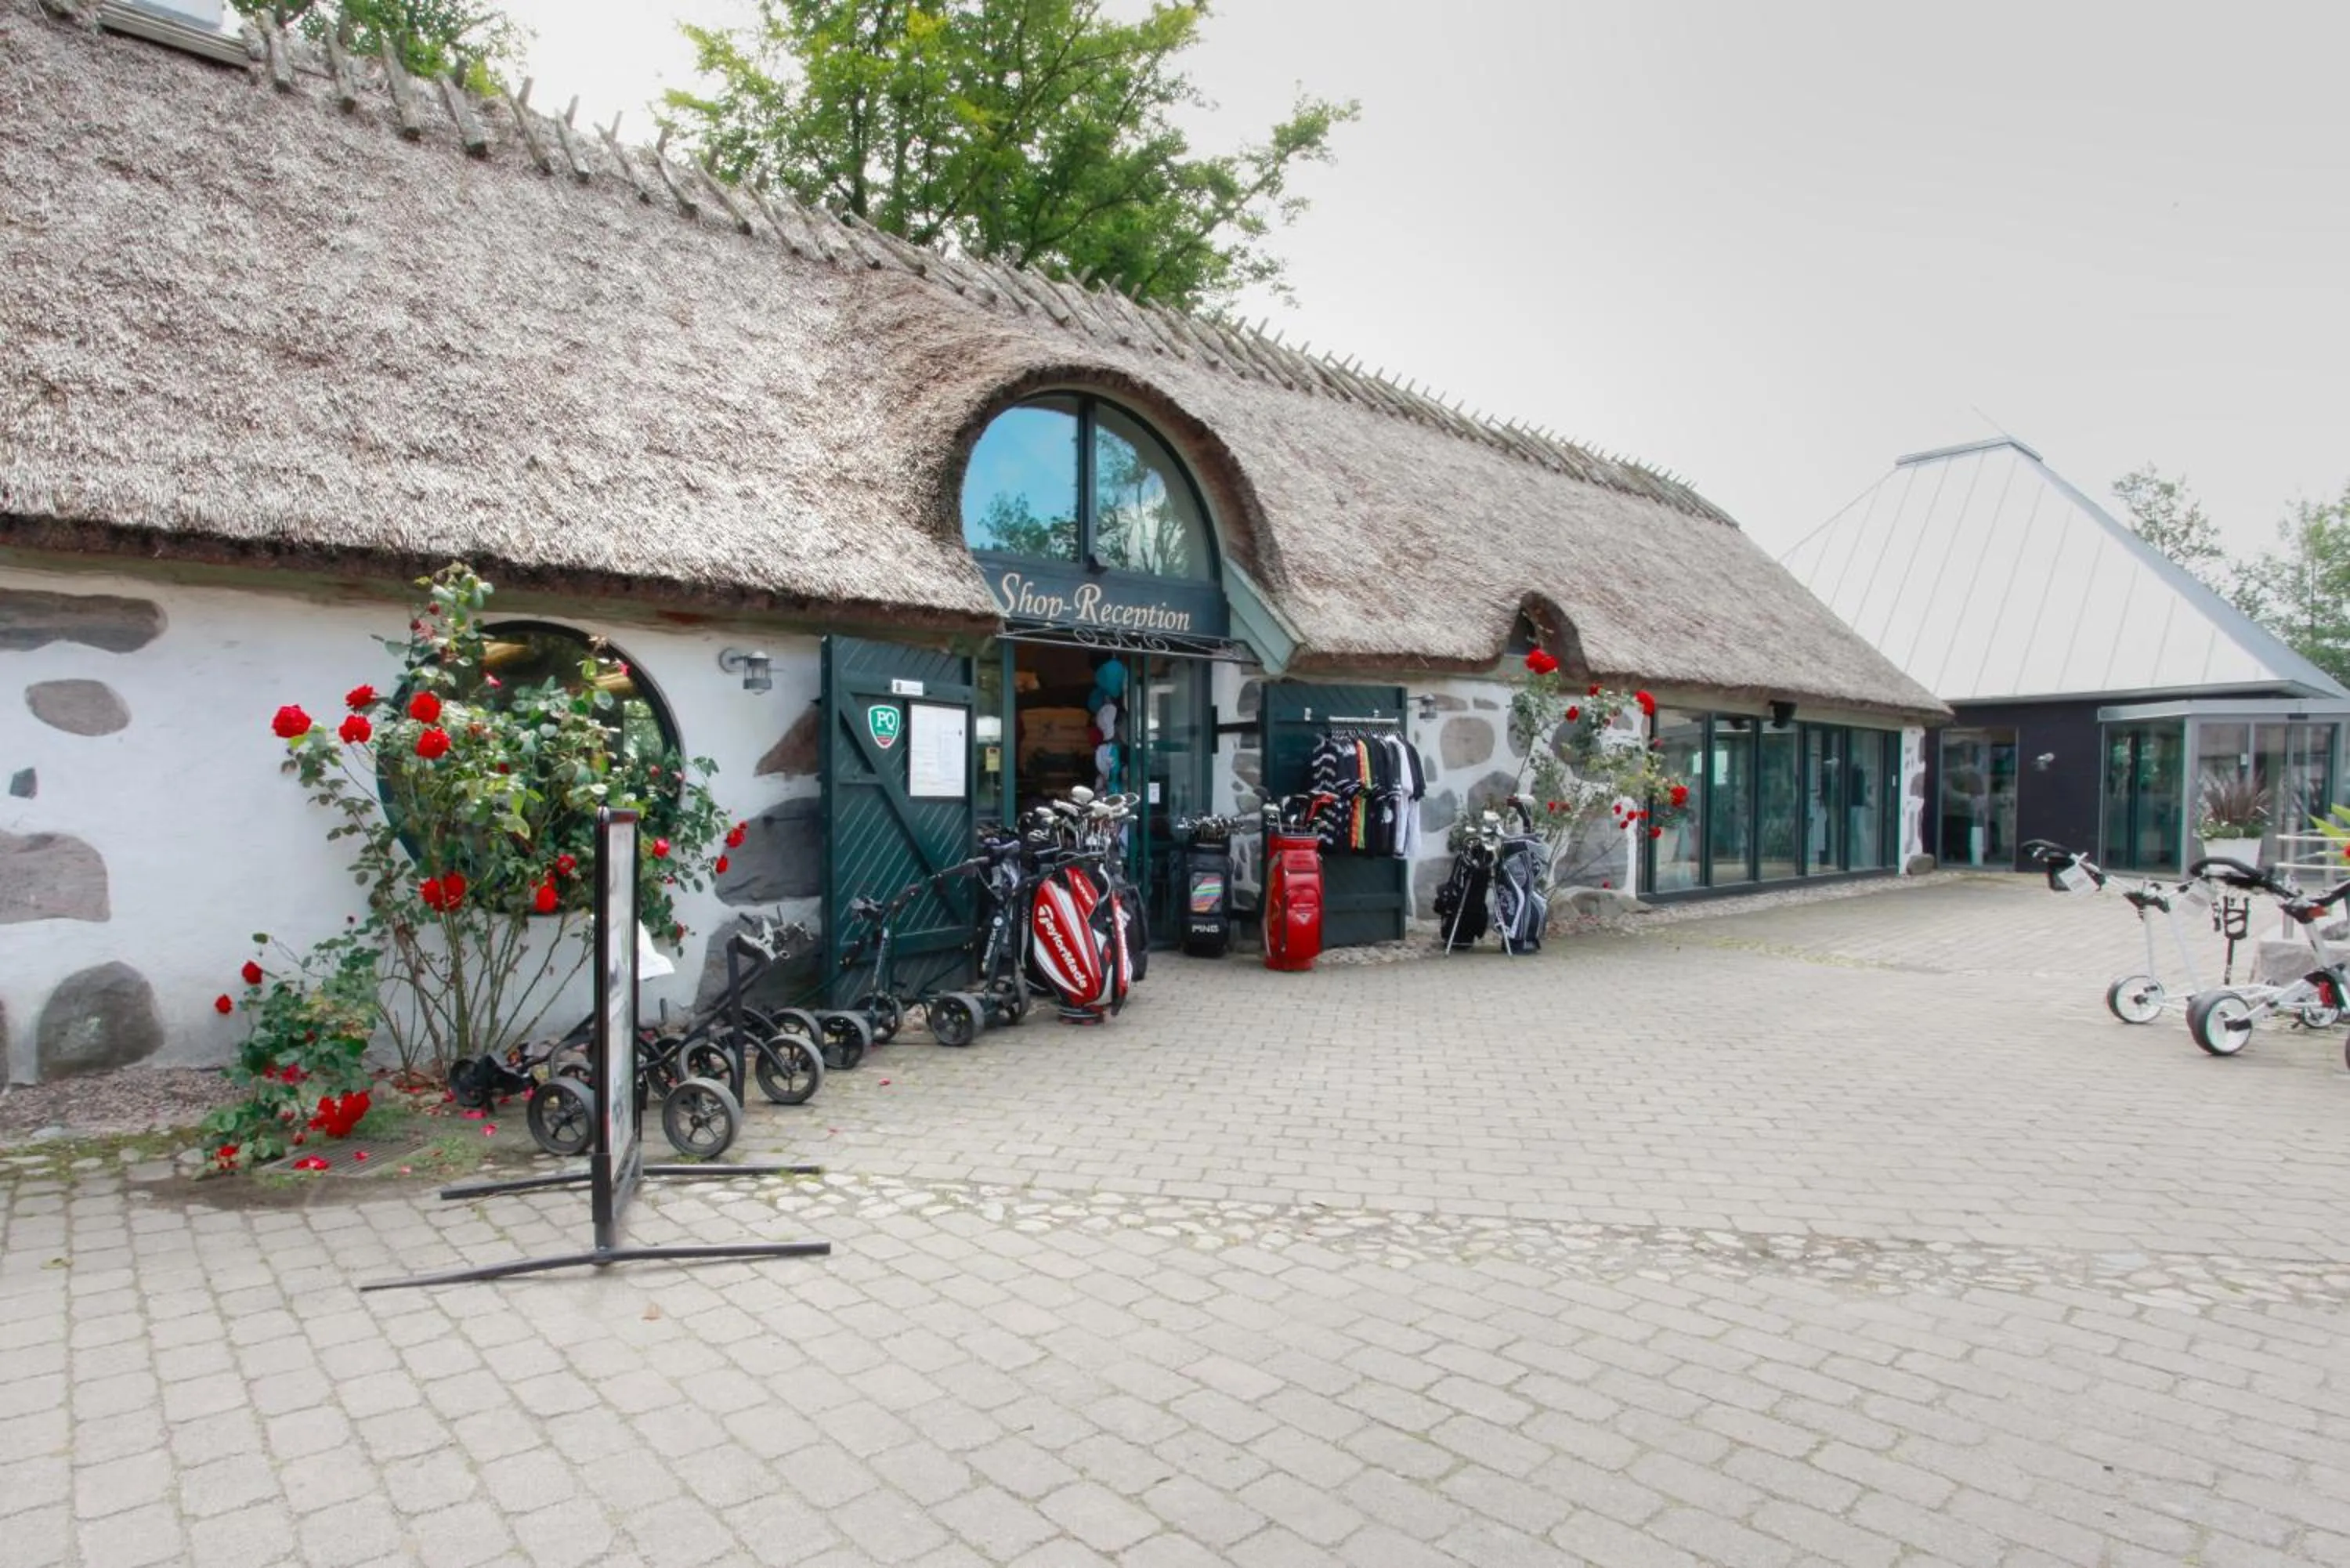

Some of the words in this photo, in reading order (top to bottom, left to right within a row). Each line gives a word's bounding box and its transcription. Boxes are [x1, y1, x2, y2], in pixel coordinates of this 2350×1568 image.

[1002, 573, 1191, 630] Shop-Reception
[1038, 904, 1088, 988] TaylorMade
[1191, 924, 1220, 933] PING
